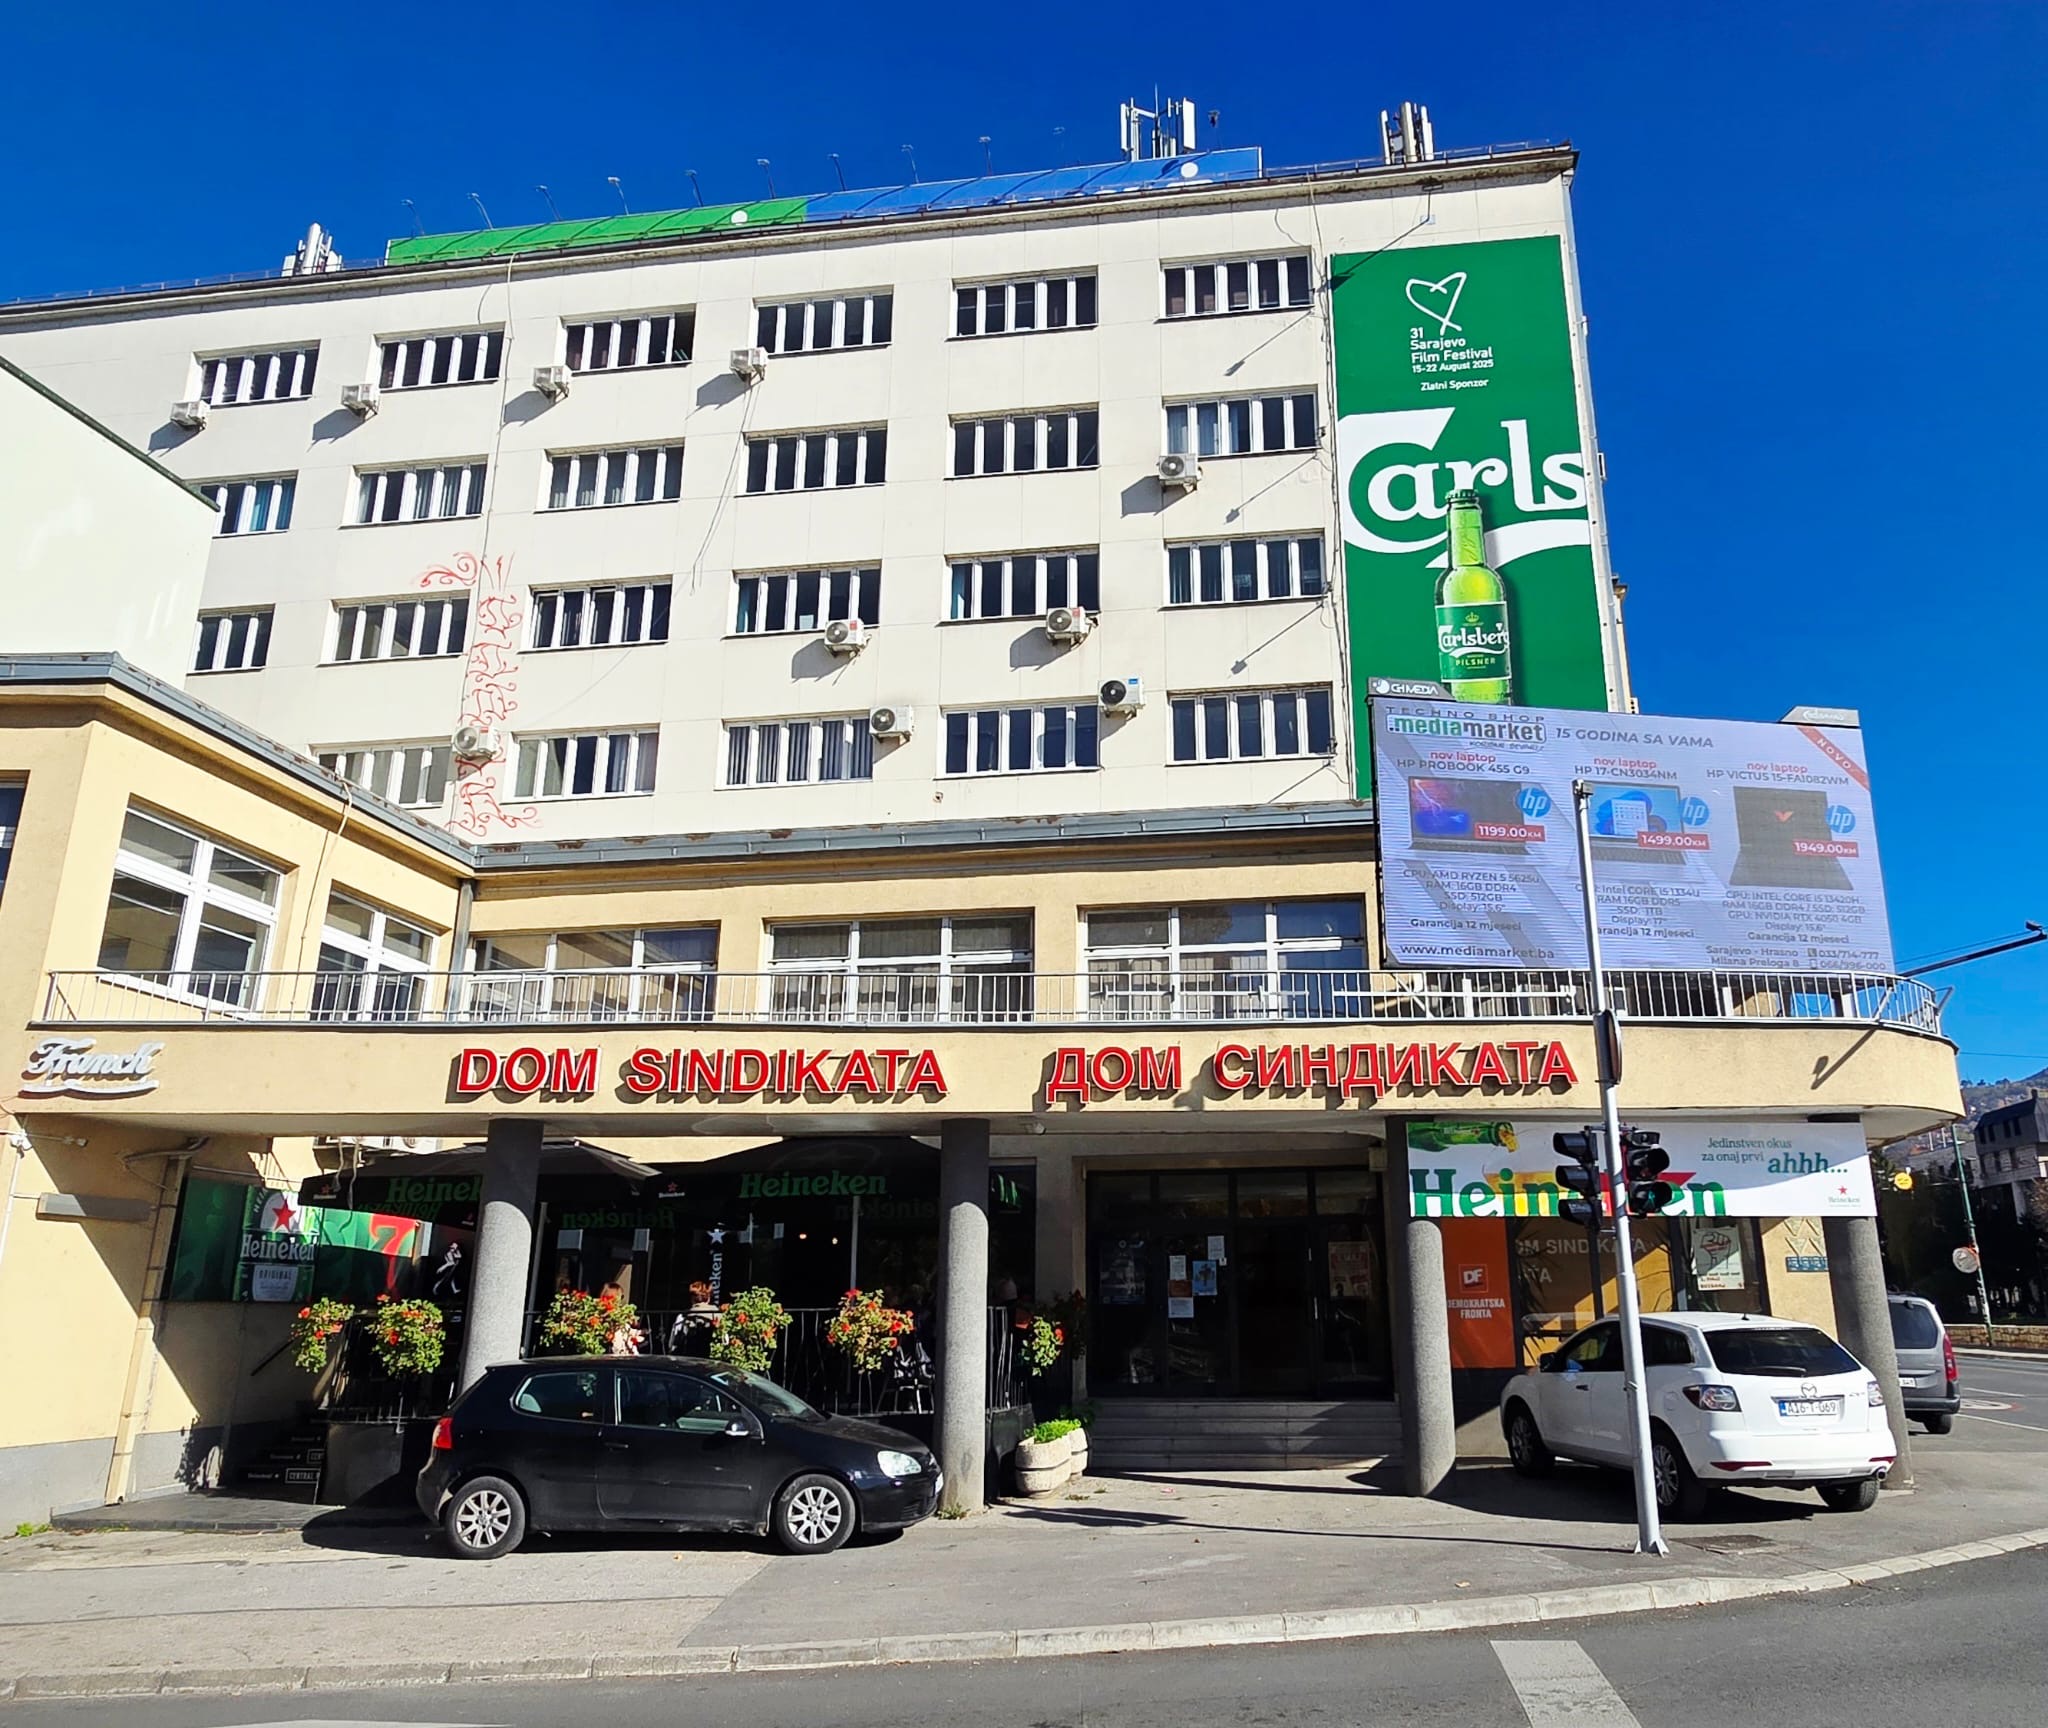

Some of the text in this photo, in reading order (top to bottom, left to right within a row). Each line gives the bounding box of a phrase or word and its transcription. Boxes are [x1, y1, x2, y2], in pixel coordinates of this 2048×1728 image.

[1410, 327, 1423, 339] 31
[1410, 338, 1466, 350] Sarajevo
[1411, 346, 1493, 364] Film Festival
[1412, 359, 1494, 373] 15-22 August 2025
[1420, 379, 1489, 391] Zlatni Sponzor
[1438, 623, 1510, 653] Carlsberg
[1455, 658, 1496, 666] PILSNER
[1386, 706, 1544, 723] TECHNO SHOP
[1556, 728, 1714, 748] 15 GODINA SA VAMA
[1430, 750, 1496, 764] nov laptop
[1816, 738, 1851, 769] NOVO
[1397, 759, 1530, 775] HP PROBOOK 455 G9
[1593, 757, 1657, 770] nov laptop
[1747, 762, 1808, 774] nov laptop
[1575, 765, 1678, 780] HP 17-CN3034NM
[1706, 769, 1724, 778] HP
[1726, 770, 1769, 781] VICTUS
[1522, 789, 1547, 817] hp
[1682, 797, 1706, 825] hp
[1830, 805, 1851, 833] hp
[1432, 870, 1458, 880] AMD
[1461, 872, 1497, 882] RYZEN
[1456, 881, 1482, 891] 16GB
[1485, 883, 1517, 893] DDR4
[1471, 892, 1503, 902] 512GB
[1410, 918, 1522, 931] Garancija 12 mjeseci
[1597, 926, 1639, 936] arancija
[1640, 928, 1651, 936] 12
[1747, 931, 1849, 944] Garancija 12 mjeseci
[1400, 945, 1555, 960] www.mediamarket.ba
[1705, 946, 1751, 957] Sarajevo
[1760, 947, 1799, 957] Hrasno
[27, 1037, 165, 1087] Franck
[456, 1047, 948, 1095] DOM SINDIKATA
[1046, 1040, 1578, 1103] ДОМ СИНДИКАТА
[1707, 1137, 1792, 1149] Jedinstven okus
[1702, 1152, 1847, 1173] za onaj prvi ahhh...
[740, 1170, 887, 1199] Heineken
[1409, 1168, 1727, 1217] Heinen
[240, 1231, 317, 1262] Heineken
[1463, 1269, 1483, 1284] DF
[1460, 1309, 1492, 1319] FRONTA
